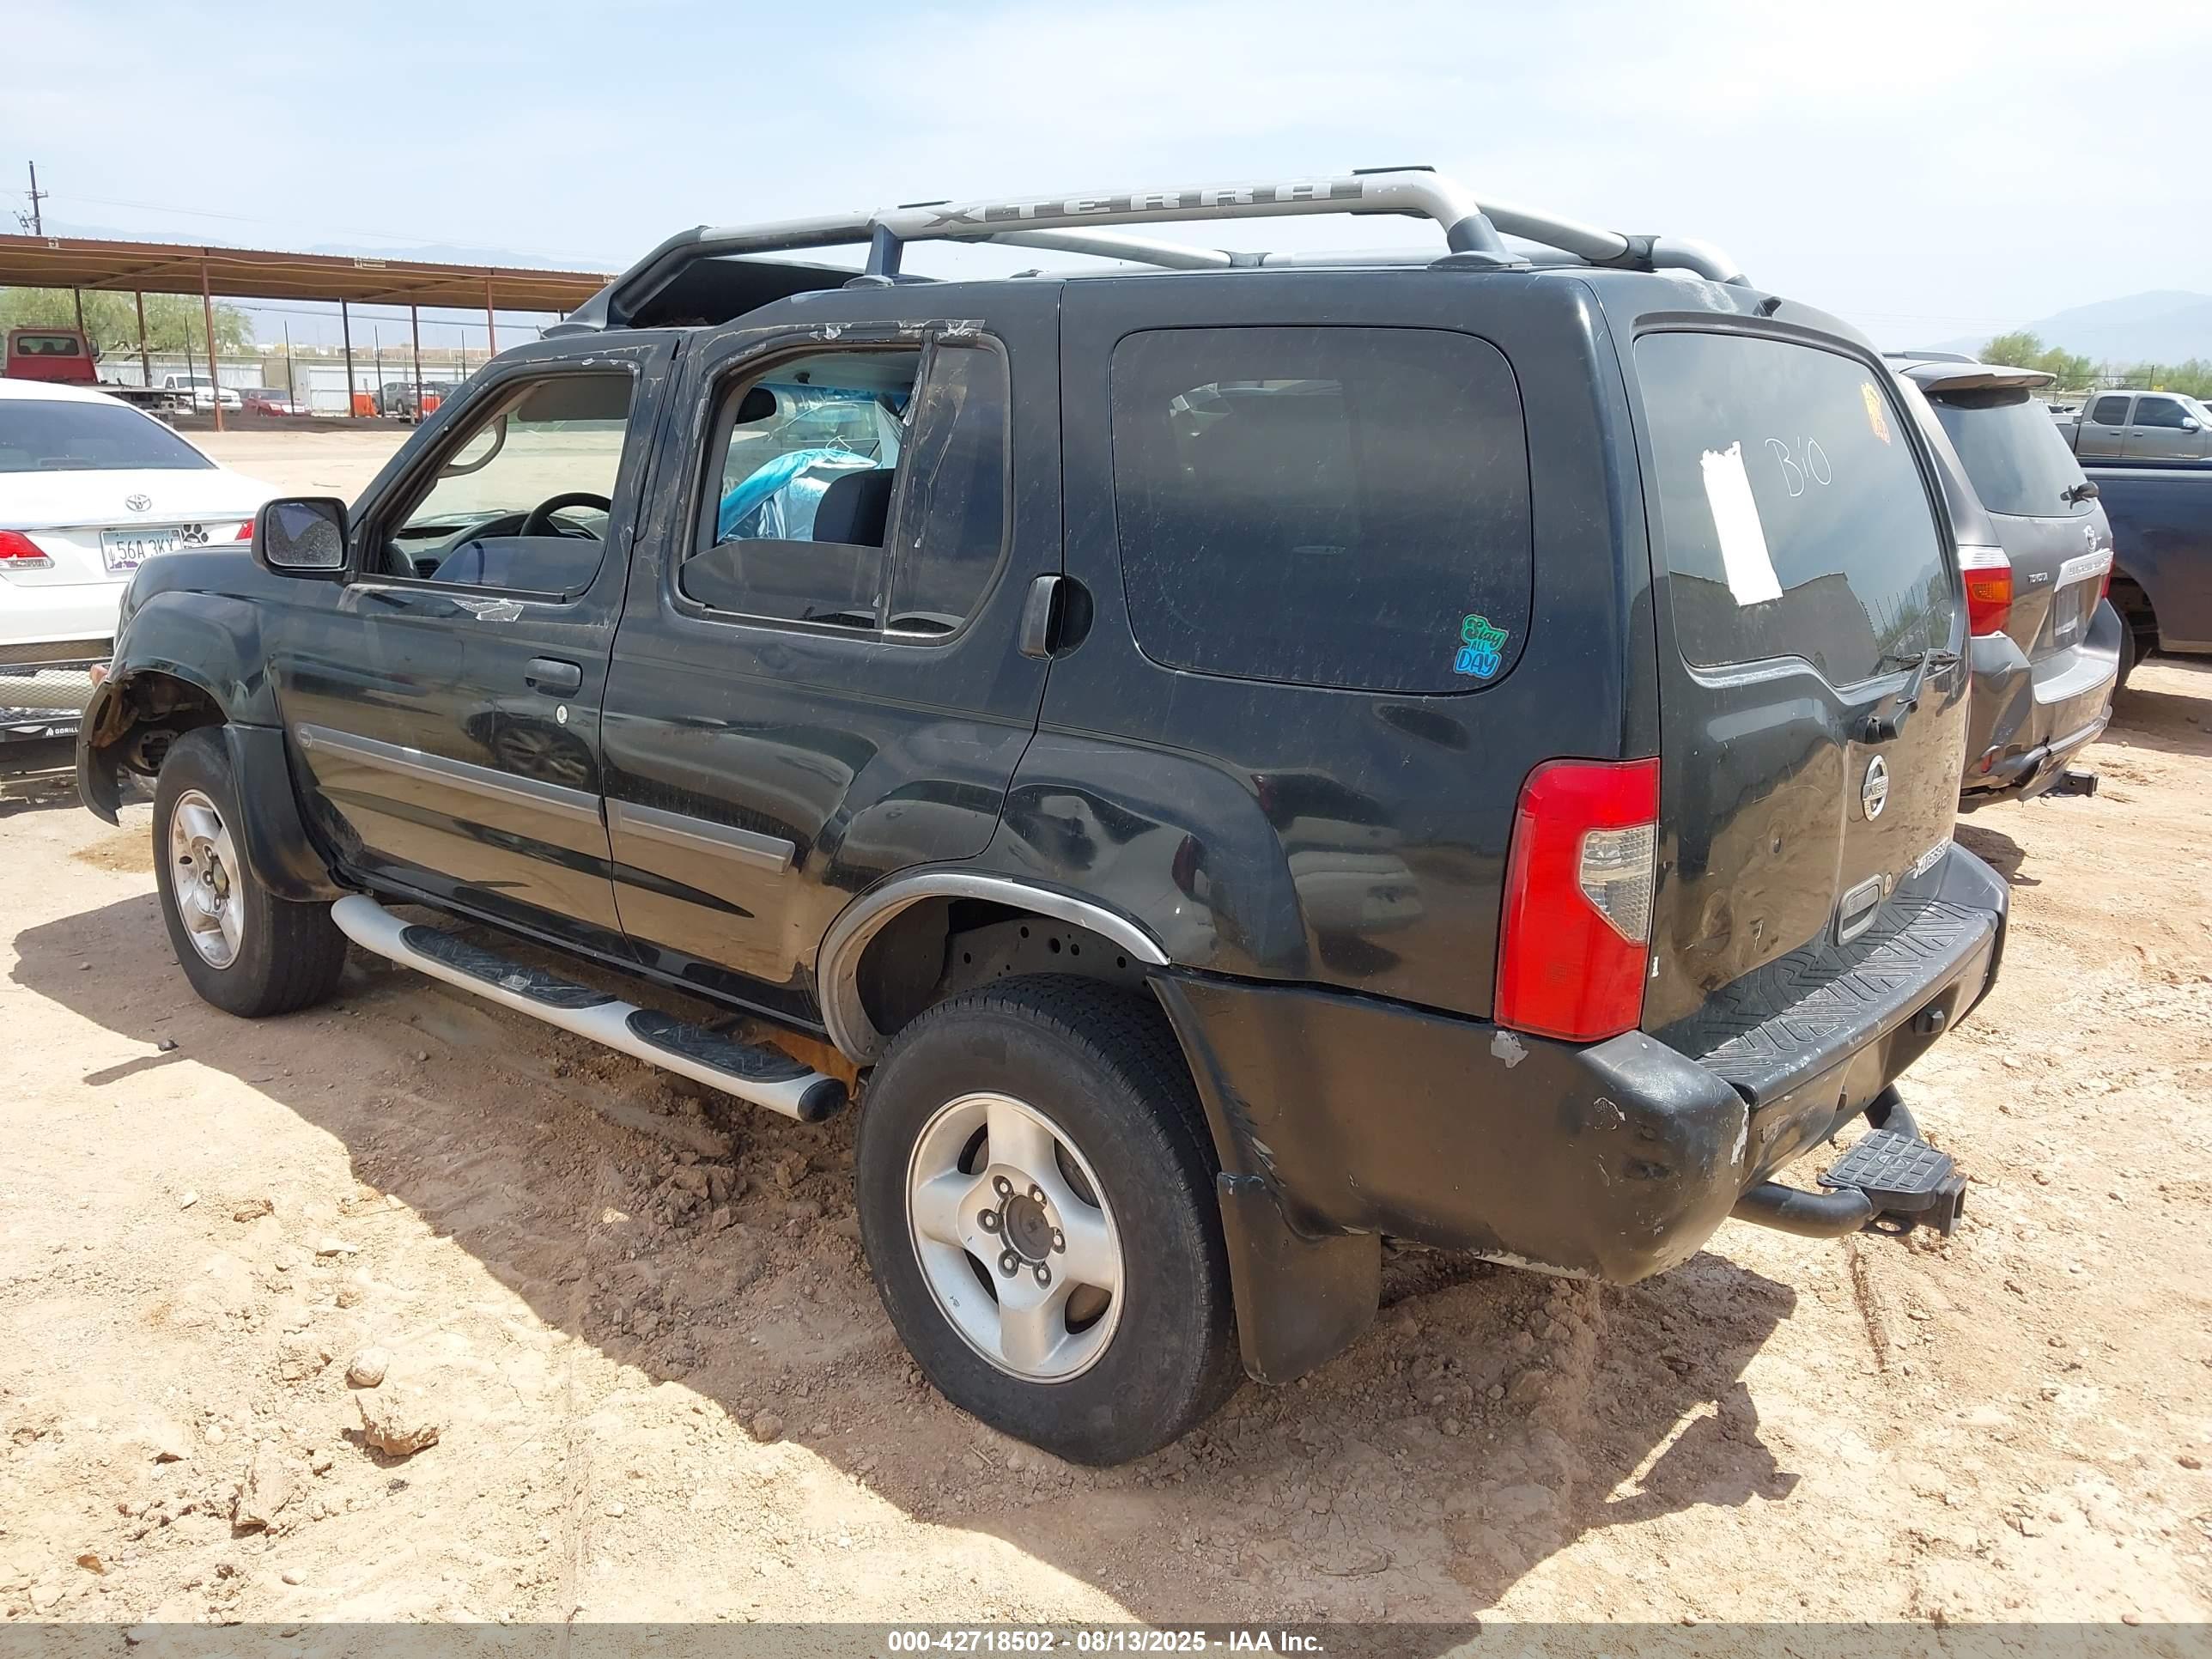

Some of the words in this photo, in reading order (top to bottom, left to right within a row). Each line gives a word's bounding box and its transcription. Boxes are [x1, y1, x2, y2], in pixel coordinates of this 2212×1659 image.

[924, 183, 1331, 228] XTERRA
[117, 539, 146, 560] 56A
[1457, 650, 1497, 675] DAY
[55, 726, 79, 735] GORILL
